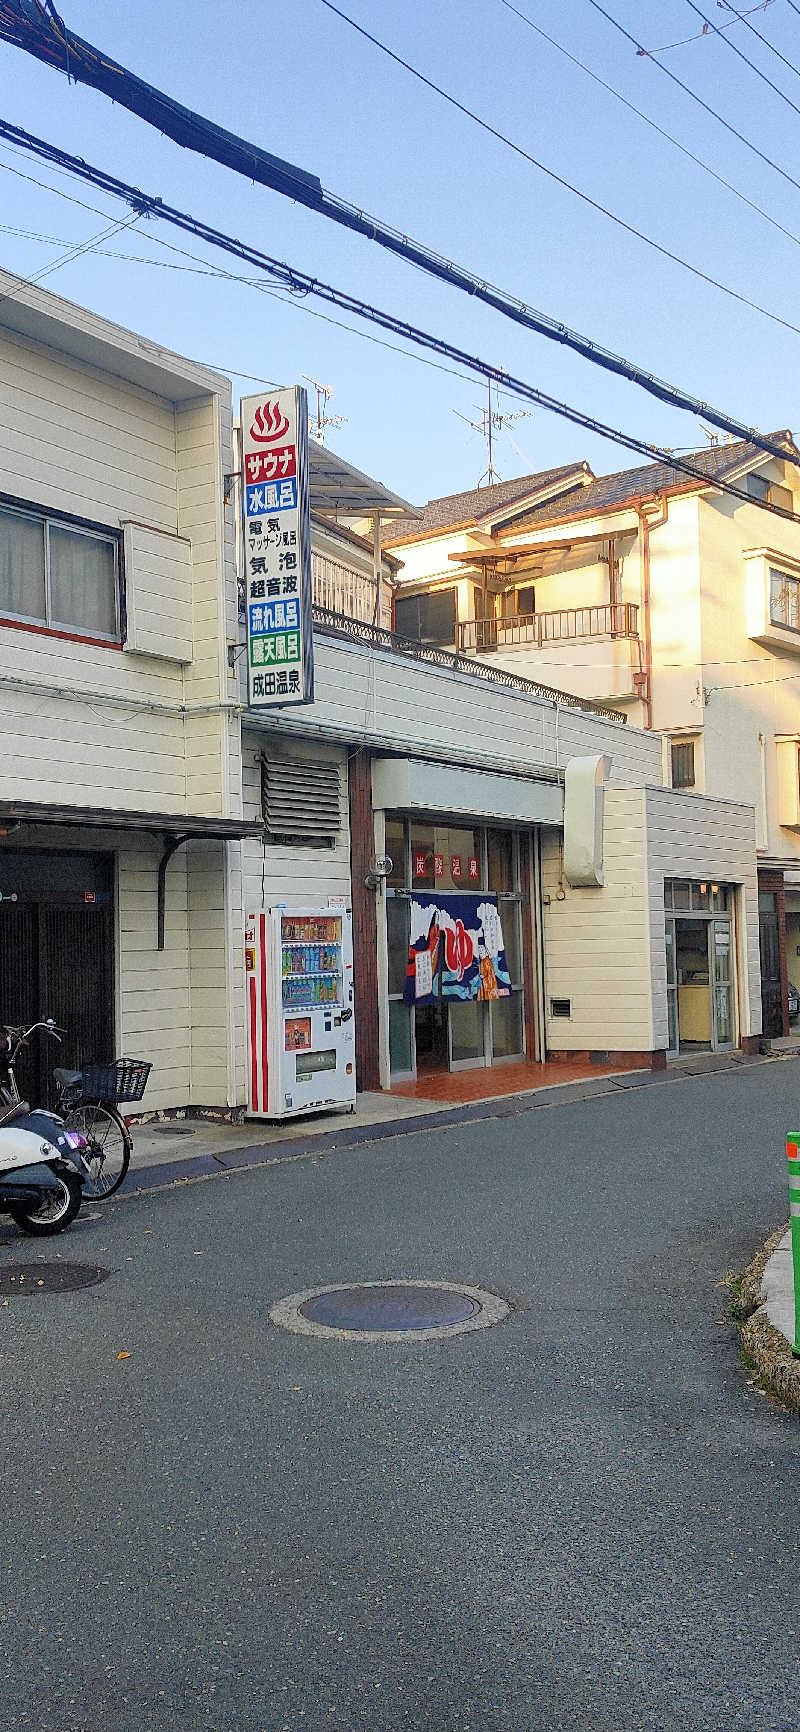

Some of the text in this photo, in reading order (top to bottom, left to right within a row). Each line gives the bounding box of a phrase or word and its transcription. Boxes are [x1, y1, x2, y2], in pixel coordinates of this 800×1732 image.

[248, 449, 293, 480] サウナ
[249, 481, 295, 513] 水風呂
[250, 575, 298, 598] 超音波
[252, 602, 298, 631] 流れ風呂
[253, 634, 299, 663] 露天風呂
[253, 669, 300, 697] 成田温泉
[445, 919, 474, 982] ゆ
